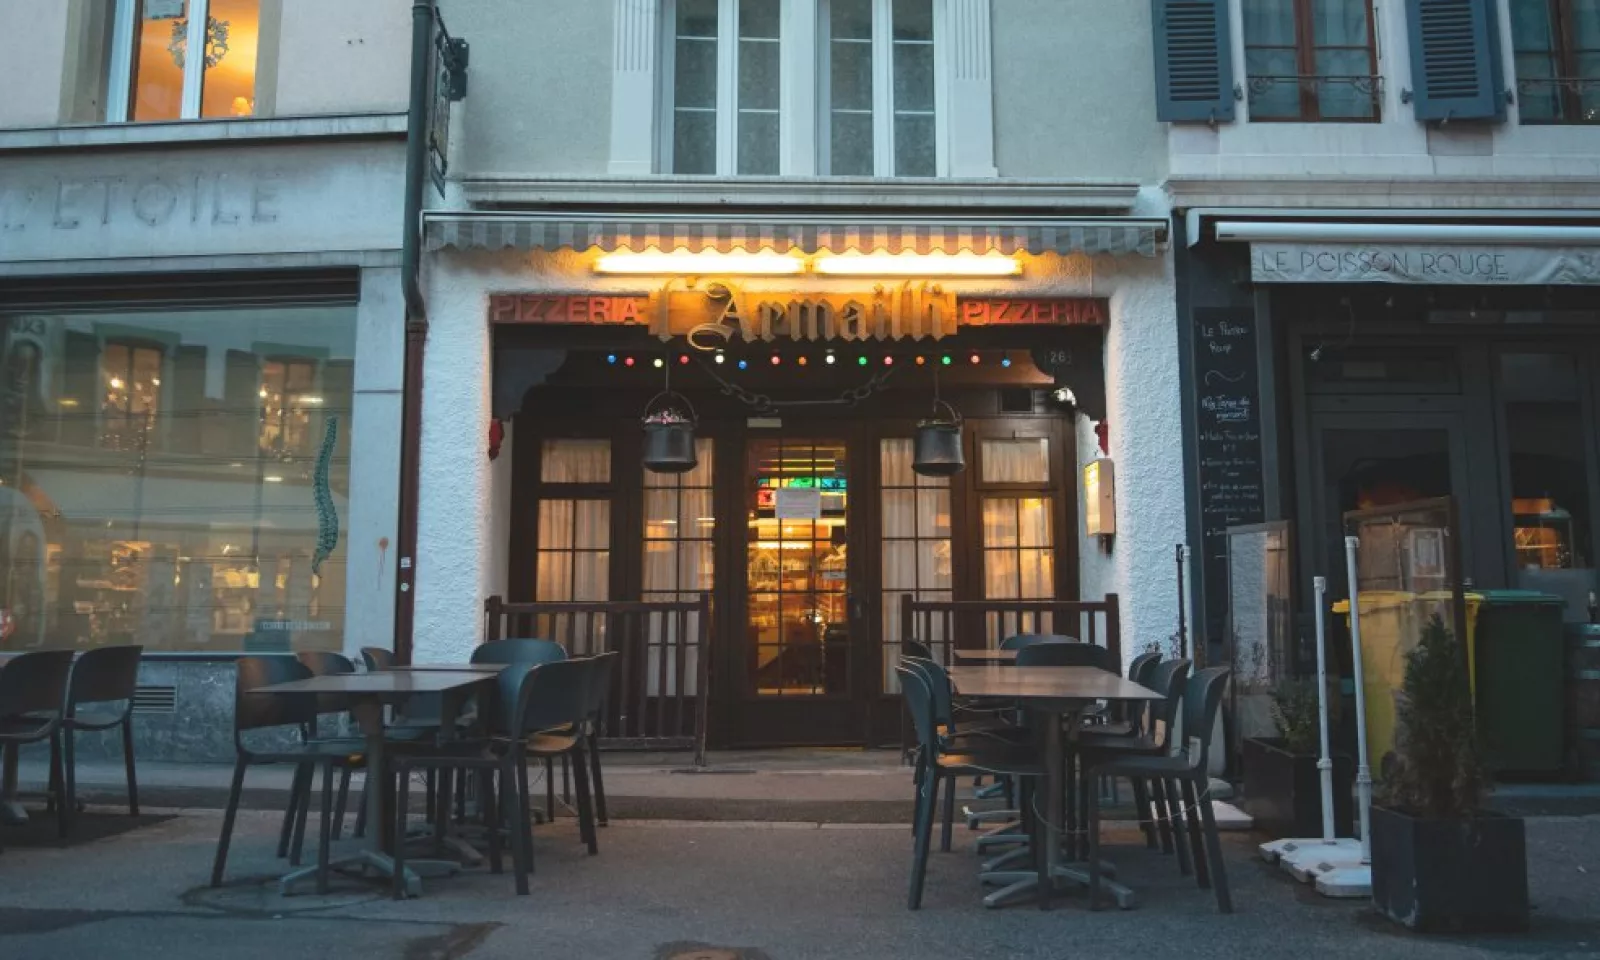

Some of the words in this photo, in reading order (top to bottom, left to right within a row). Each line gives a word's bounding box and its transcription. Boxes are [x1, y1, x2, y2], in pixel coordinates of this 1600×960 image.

[1261, 251, 1288, 272] LE
[1300, 251, 1409, 277] POISSON
[1421, 252, 1510, 276] ROUGE
[492, 296, 643, 324] PIZZERIA
[962, 299, 1101, 324] PIZZERIA
[1050, 352, 1065, 364] 26
